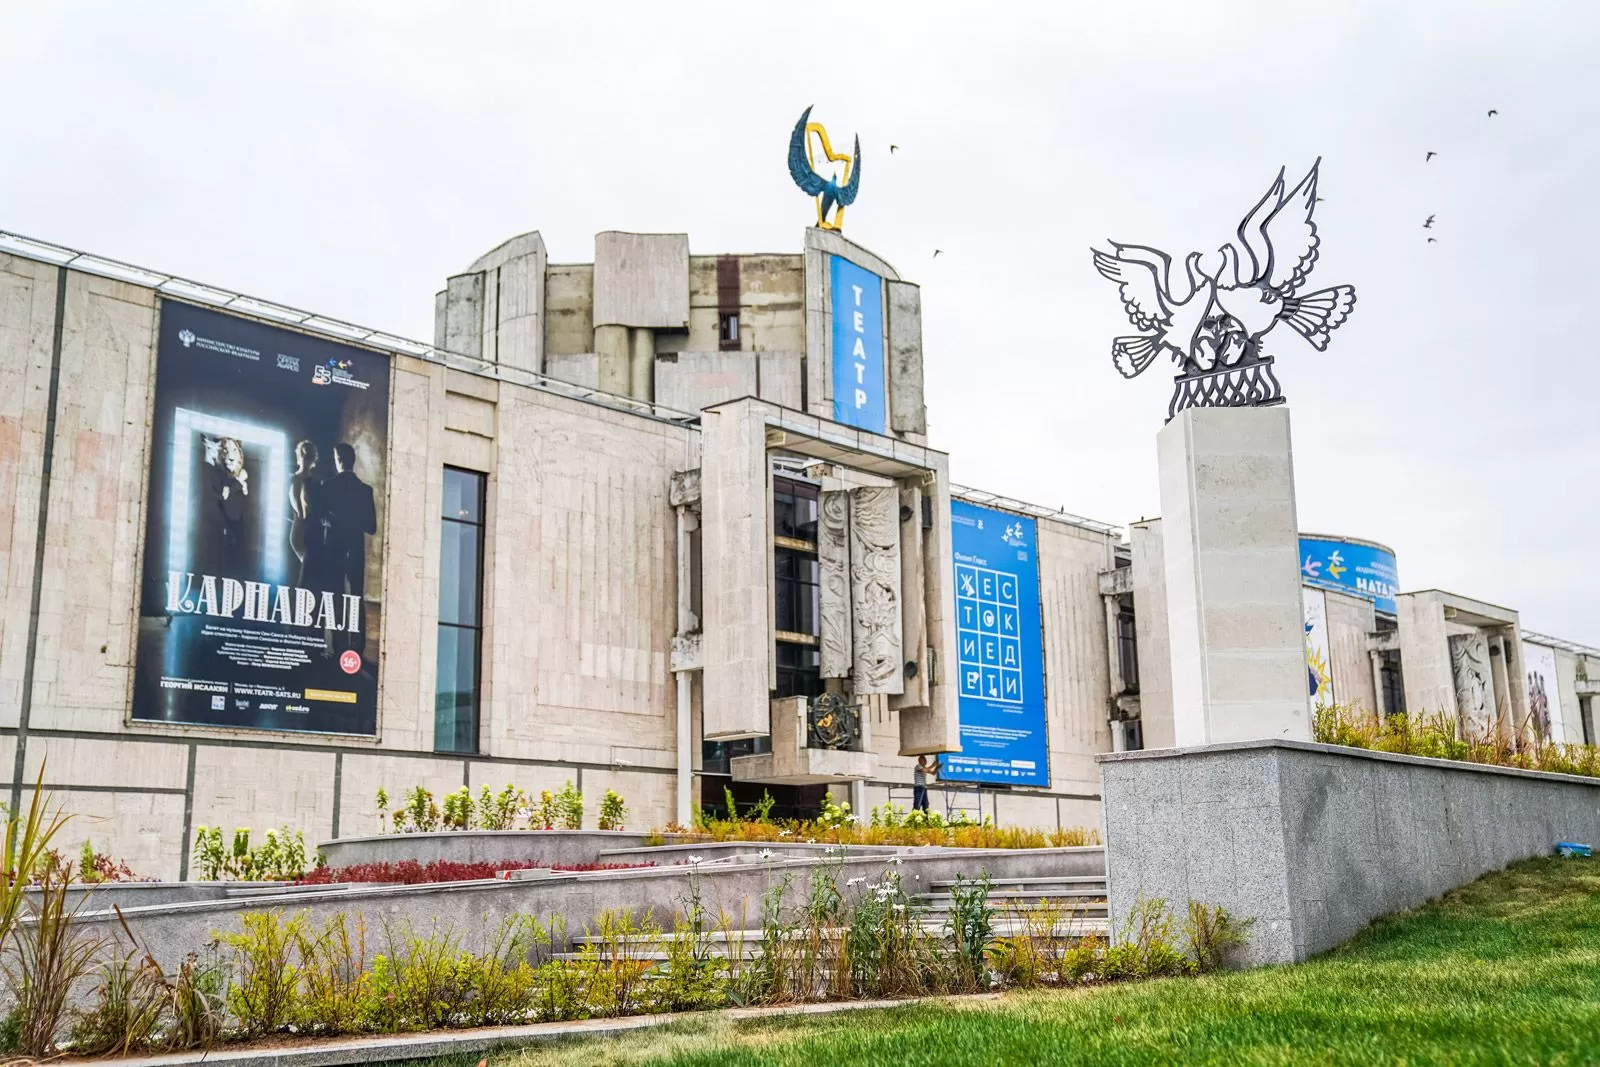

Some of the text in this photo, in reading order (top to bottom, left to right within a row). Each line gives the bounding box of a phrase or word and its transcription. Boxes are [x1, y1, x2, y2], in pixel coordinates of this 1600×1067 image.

[852, 284, 867, 409] ТЕАТР
[165, 570, 362, 633] КАРНАВАЛ
[343, 658, 357, 668] 16+
[160, 680, 193, 690] ГЕОРГИЙ
[234, 687, 301, 699] WWW.TEATR-SATS.RU
